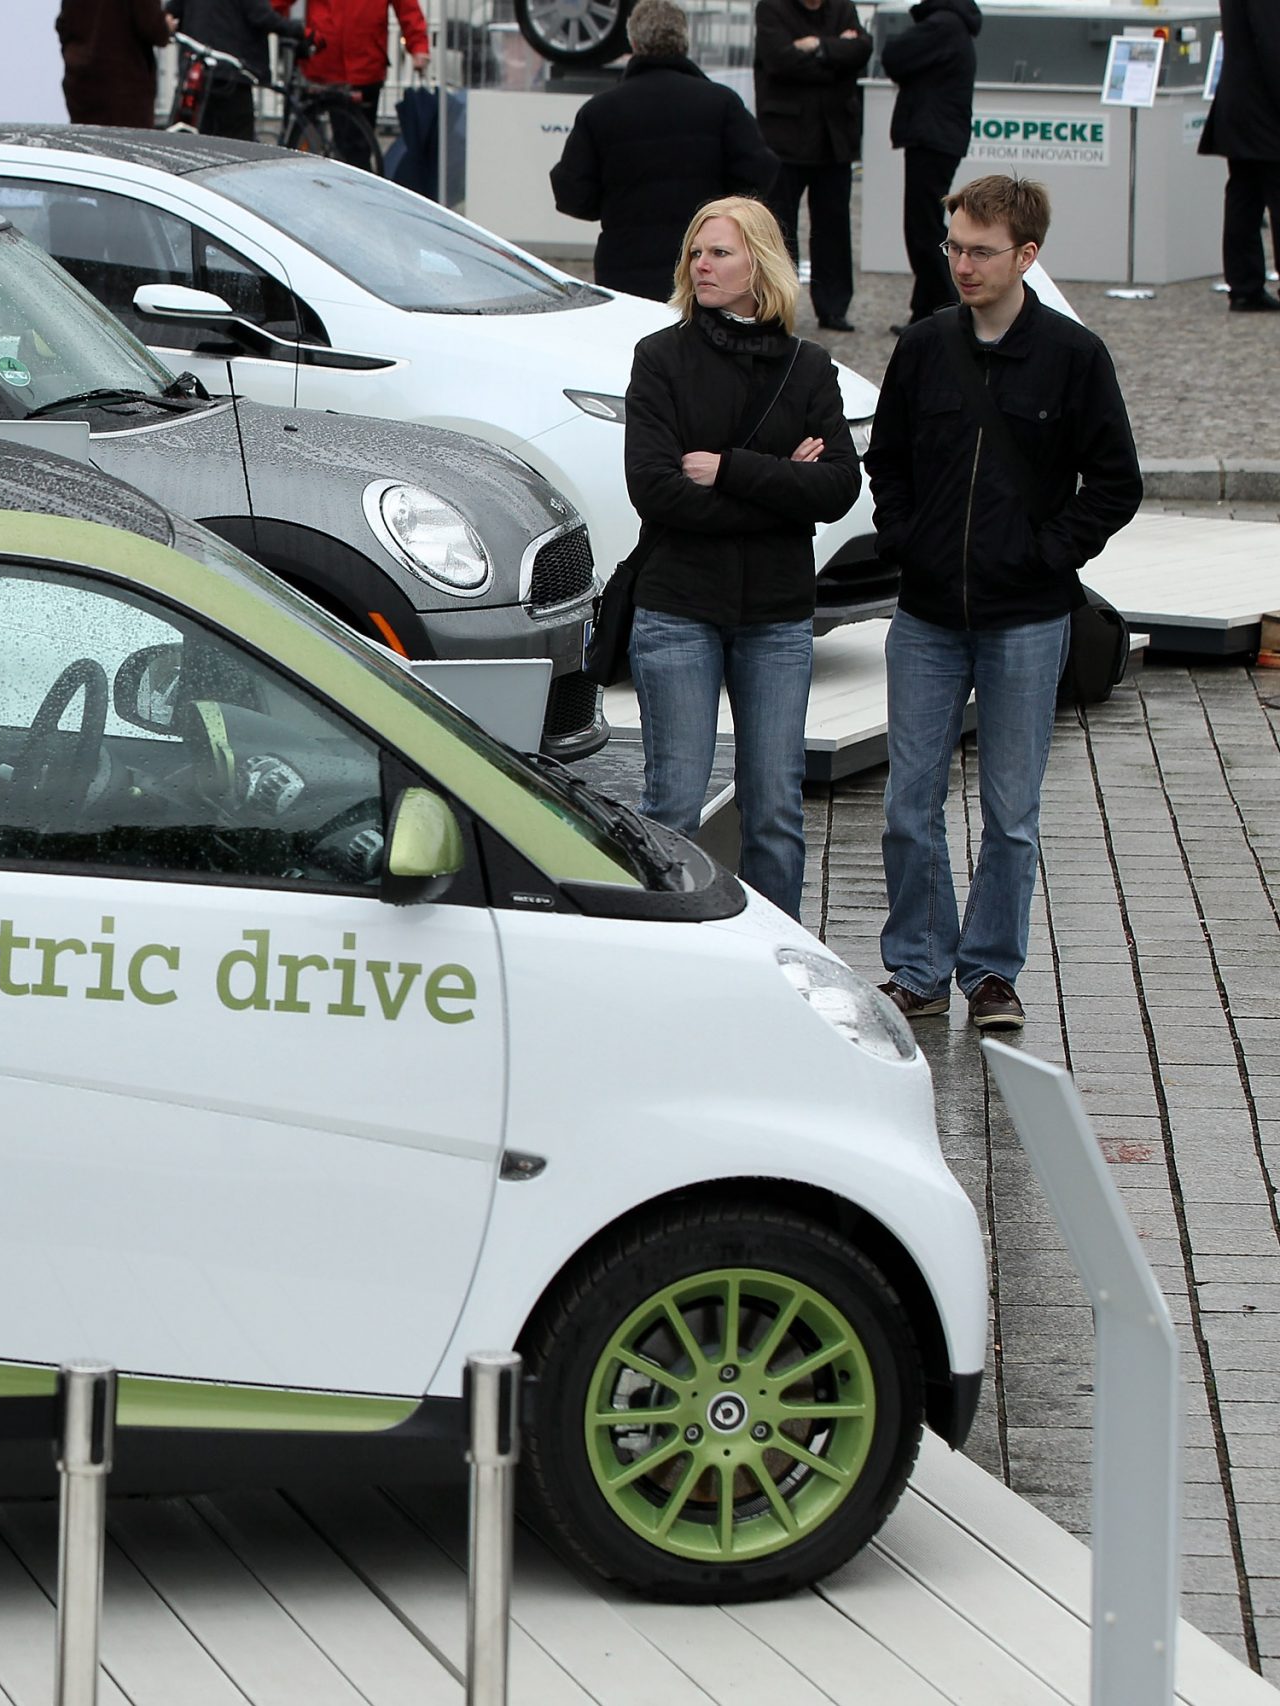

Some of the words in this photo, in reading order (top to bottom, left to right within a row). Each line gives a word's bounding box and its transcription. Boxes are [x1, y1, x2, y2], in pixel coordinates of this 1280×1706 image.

[971, 120, 1104, 143] HOPPECKE
[979, 147, 1018, 160] FROM
[1021, 149, 1104, 162] INNOVATION
[7, 359, 18, 371] 4
[216, 928, 477, 1025] drive
